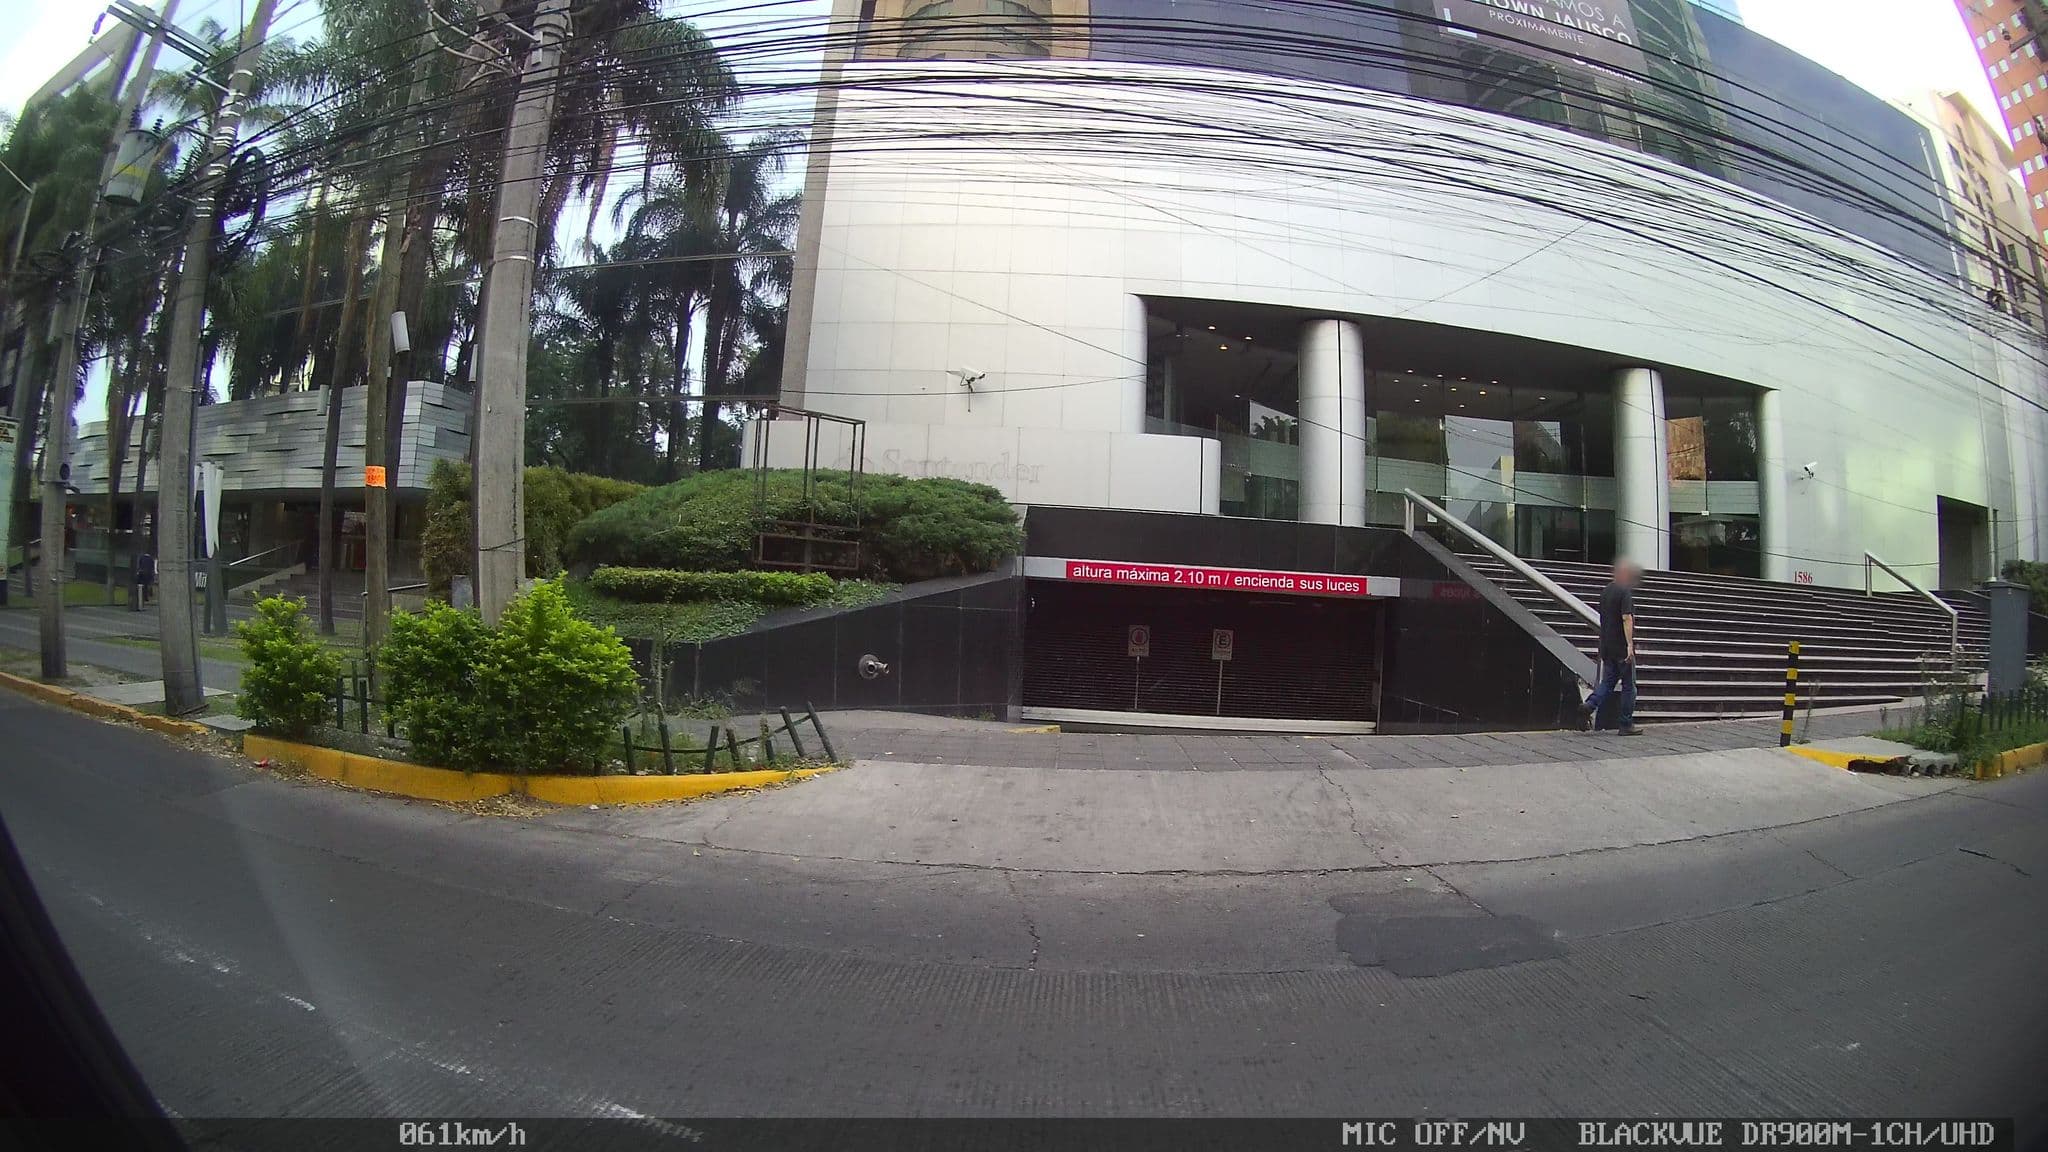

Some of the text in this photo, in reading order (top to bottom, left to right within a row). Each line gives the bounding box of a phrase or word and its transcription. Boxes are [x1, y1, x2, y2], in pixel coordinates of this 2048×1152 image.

[1485, 0, 1545, 18] OWN
[1612, 13, 1626, 29] A
[1073, 565, 1360, 592] altura máxima 2.10 m / encienda sus luces
[1794, 571, 1813, 584] 1586
